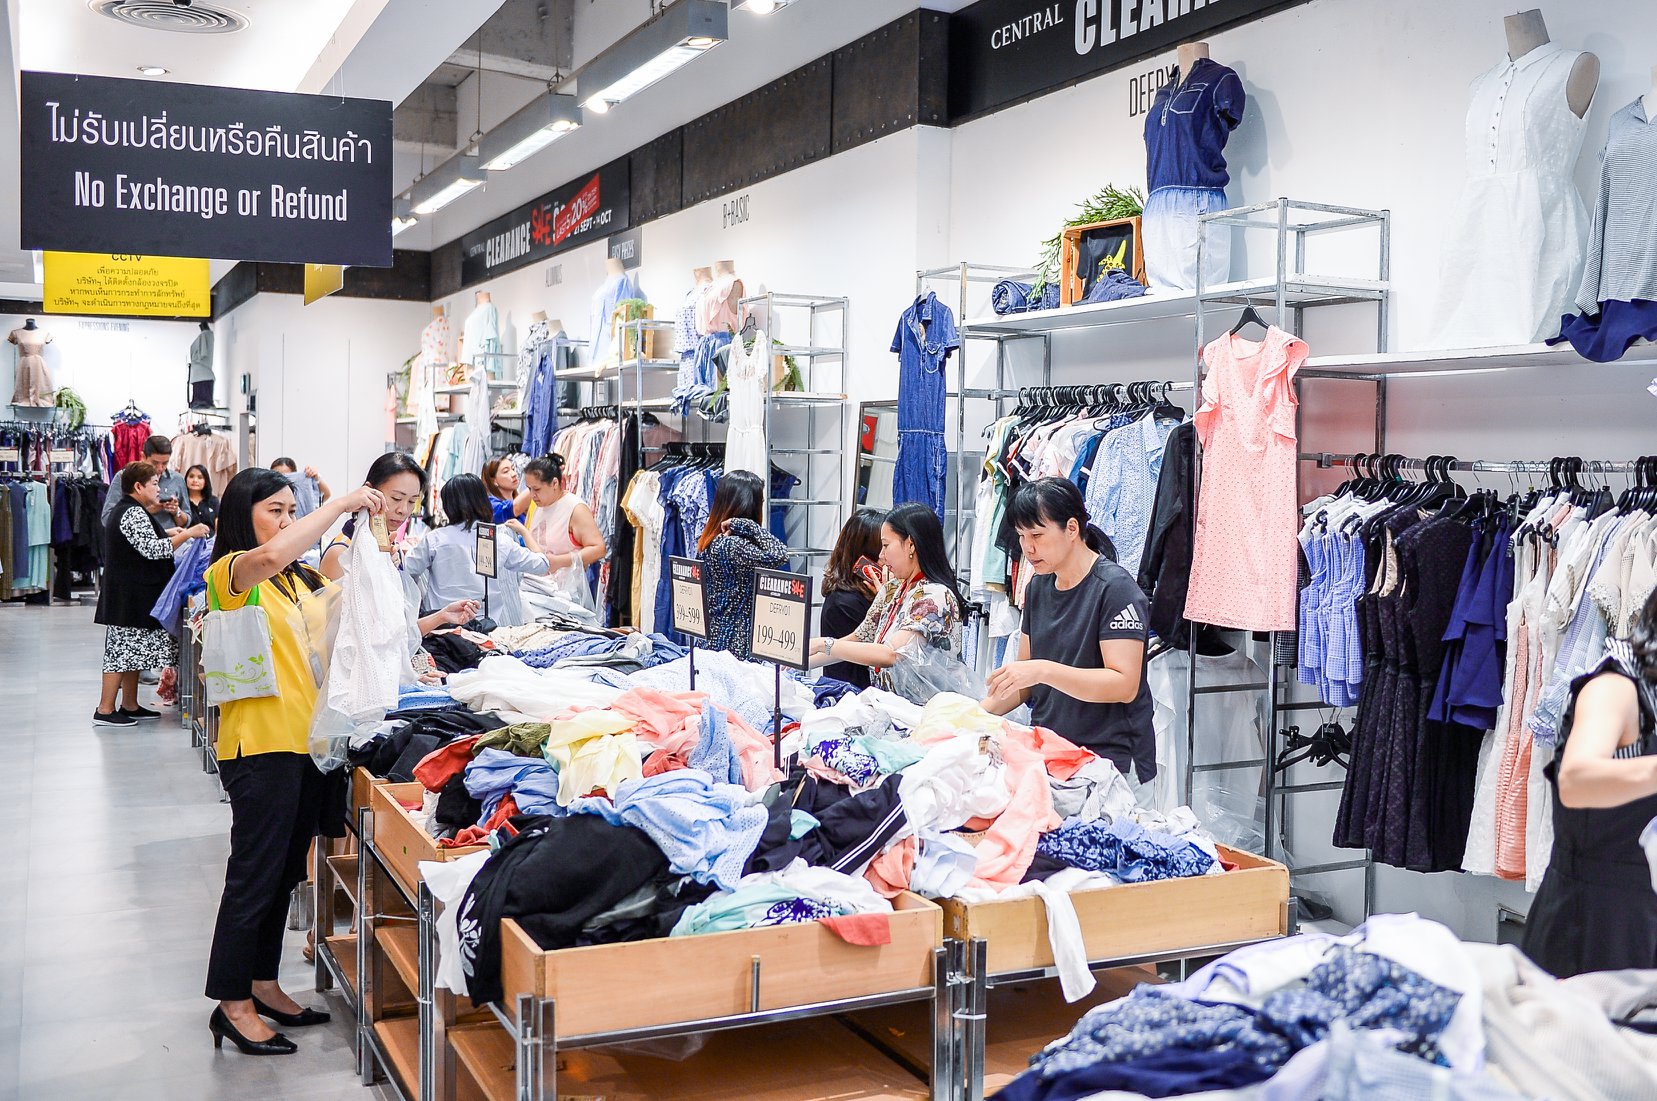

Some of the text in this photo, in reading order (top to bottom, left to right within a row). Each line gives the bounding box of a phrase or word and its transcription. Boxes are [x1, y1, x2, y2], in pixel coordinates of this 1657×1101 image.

[990, 0, 1220, 55] CENTRAL CLEA
[46, 102, 373, 163] ไม่รับเปลี่ยนหรือคืนสินค้า
[74, 171, 347, 222] No Exchange or Refund
[485, 221, 531, 269] CLEARANCE
[532, 202, 552, 247] SALE
[600, 209, 612, 225] OCT
[760, 576, 805, 598] CLEARANCE SALE
[757, 624, 796, 651] 199-499
[1109, 619, 1144, 630] adidas
